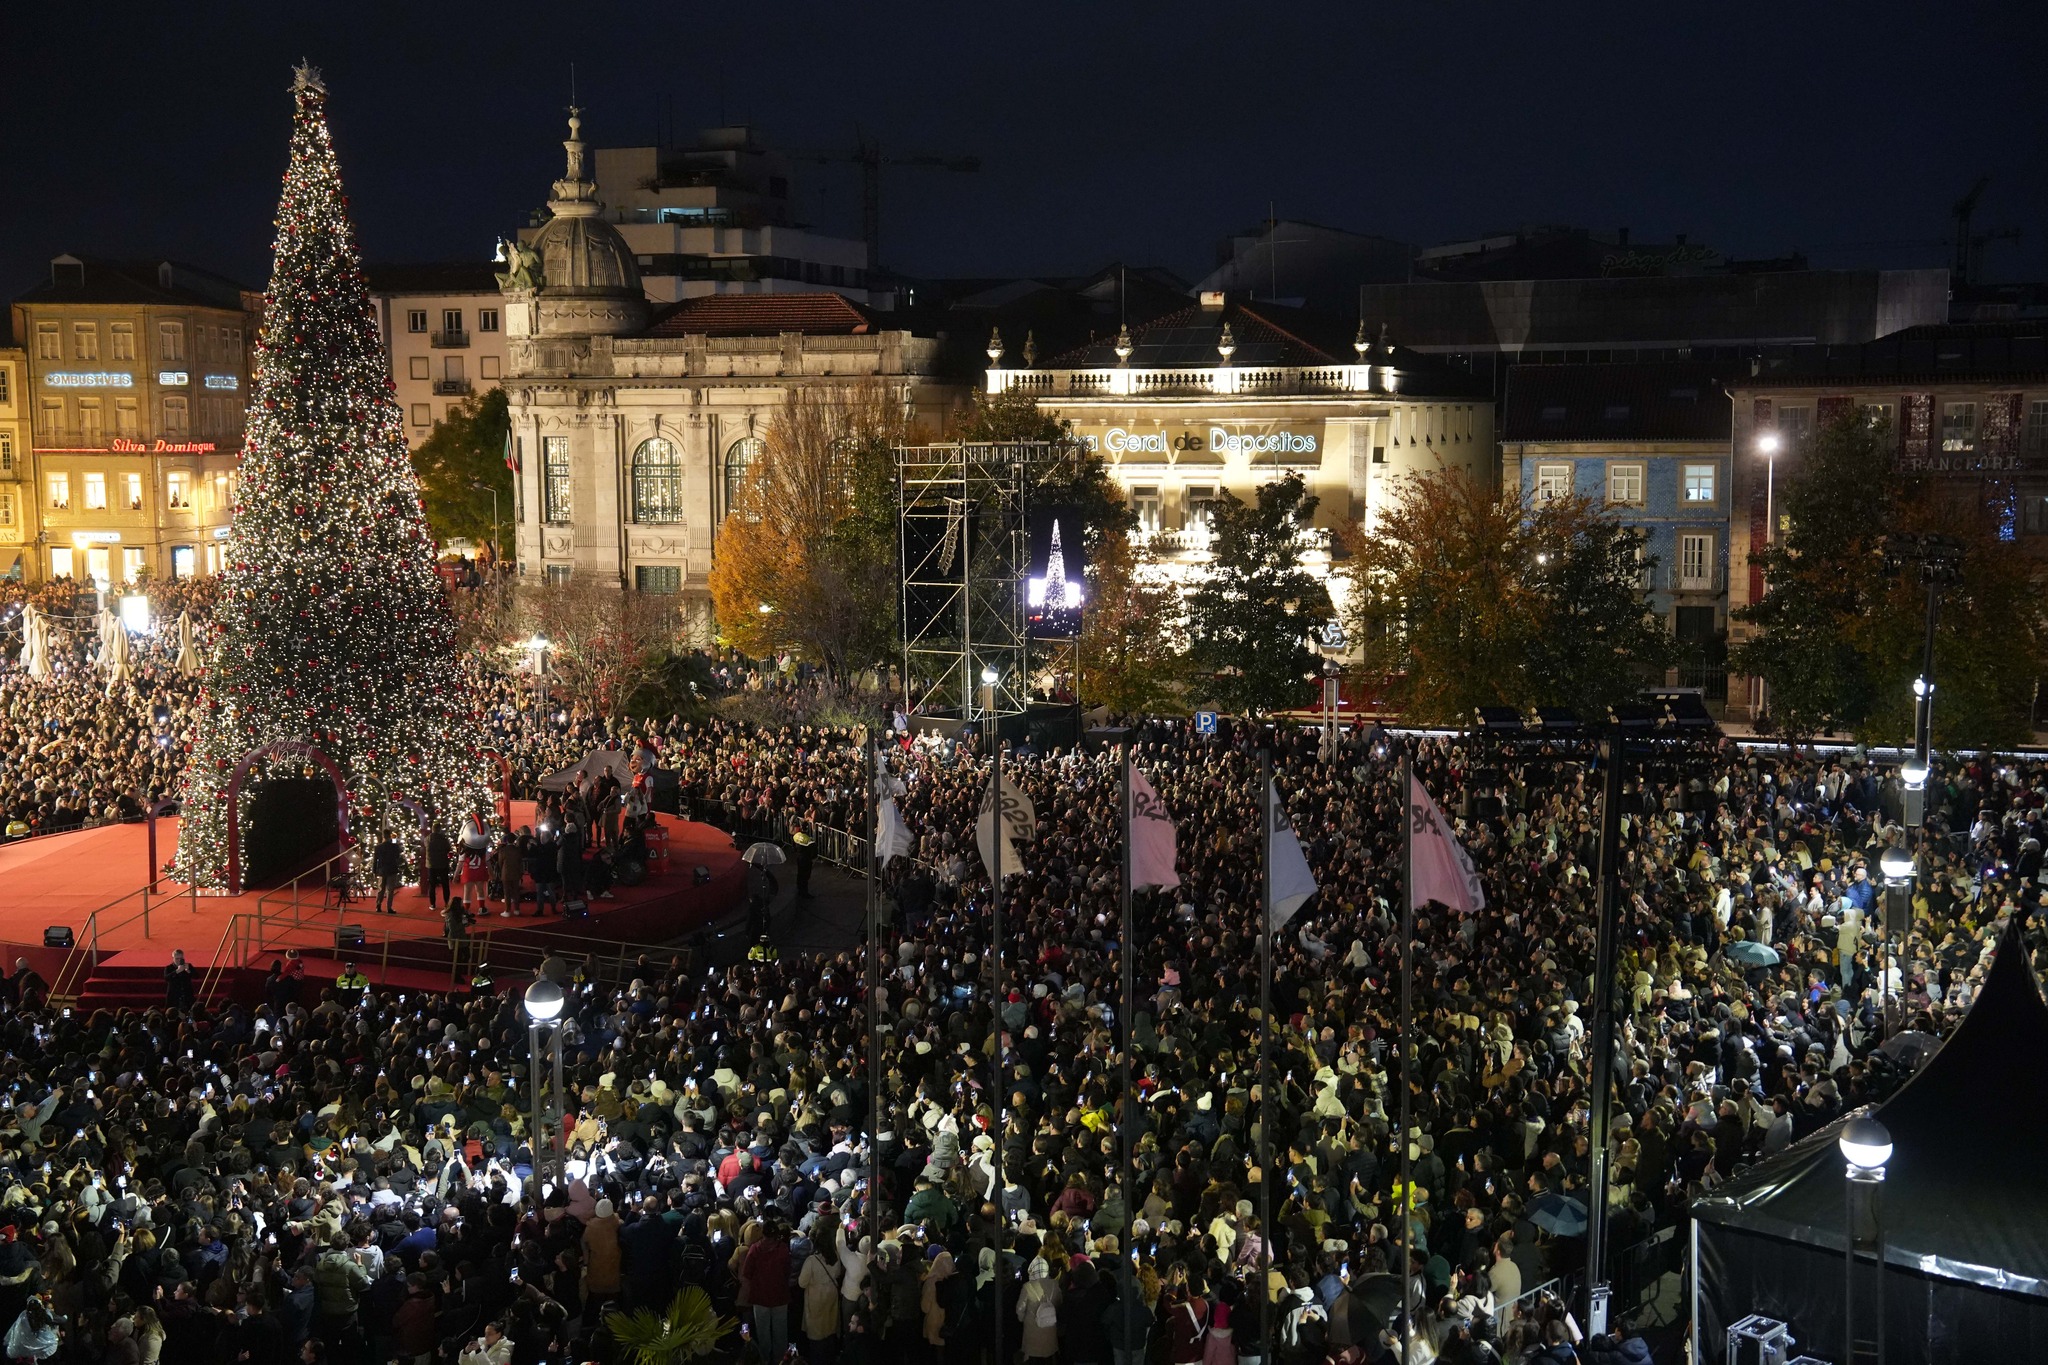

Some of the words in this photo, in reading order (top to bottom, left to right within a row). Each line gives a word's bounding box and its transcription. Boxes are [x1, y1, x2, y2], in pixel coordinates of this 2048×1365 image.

[44, 373, 131, 386] COMBUSTÍVEIS
[159, 372, 188, 386] SD
[112, 438, 146, 452] Silva
[1105, 427, 1167, 451] Geral
[1174, 432, 1203, 451] de
[1210, 427, 1316, 455] Depositos
[1900, 456, 2017, 472] FRANCFORT
[1201, 715, 1212, 730] P
